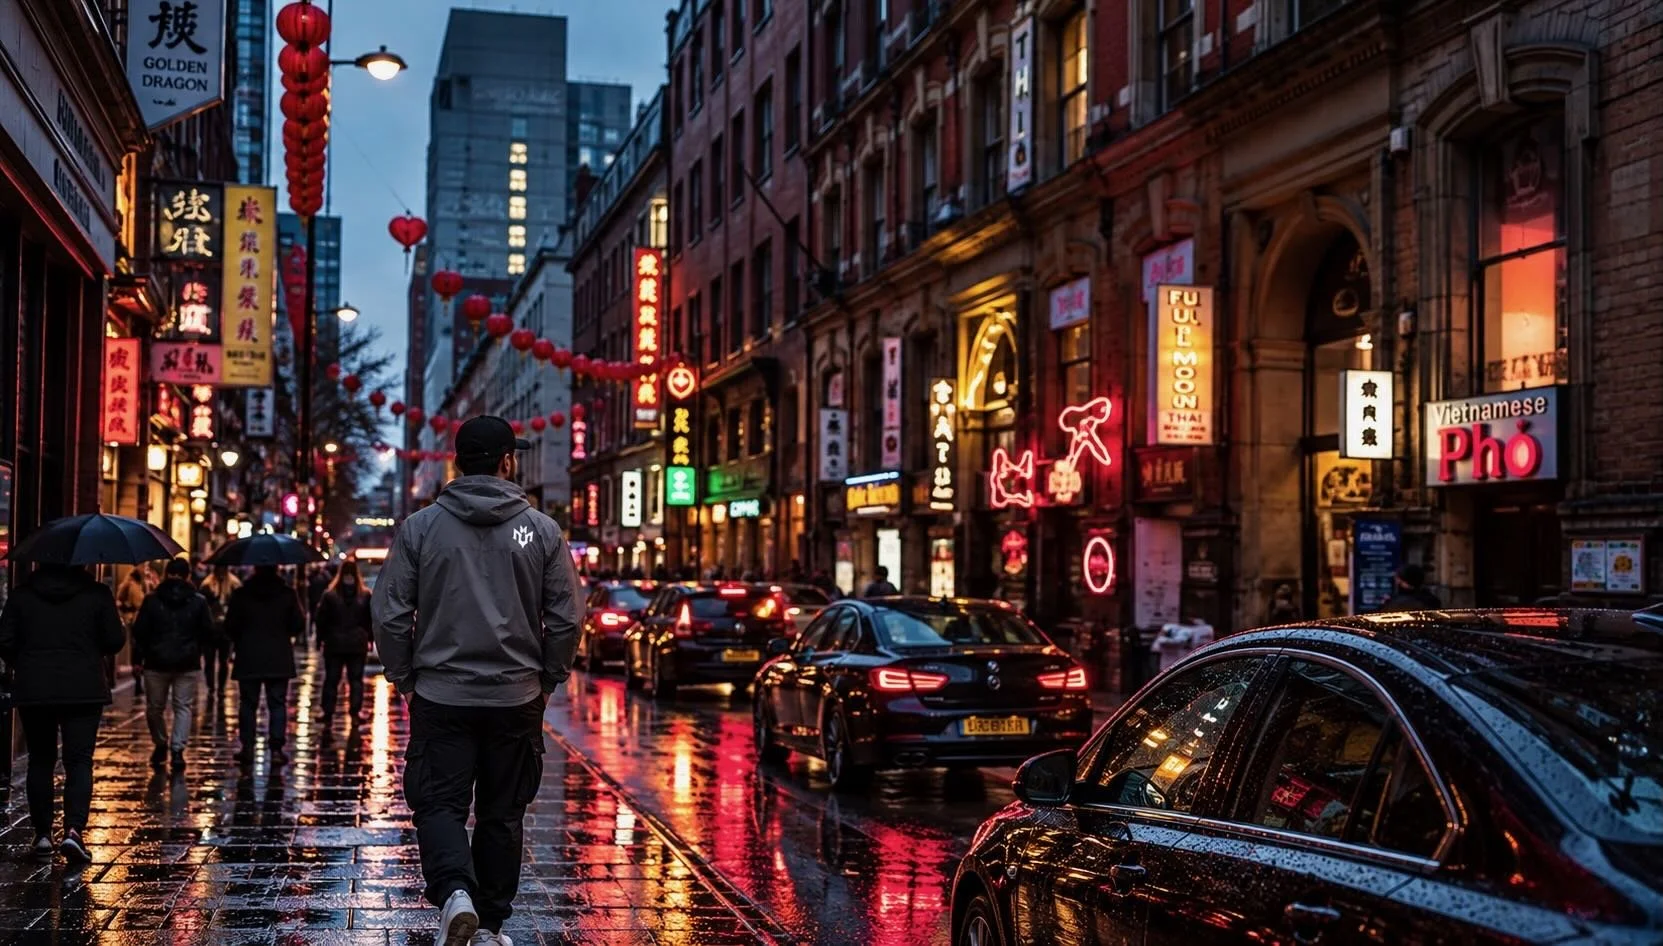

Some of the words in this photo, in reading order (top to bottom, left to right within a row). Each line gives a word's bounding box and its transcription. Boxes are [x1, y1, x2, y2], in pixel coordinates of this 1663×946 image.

[143, 56, 208, 74] GOLDEN
[142, 74, 208, 92] DRAGON
[1167, 413, 1202, 423] THAI
[1432, 395, 1547, 426] Vietnamese
